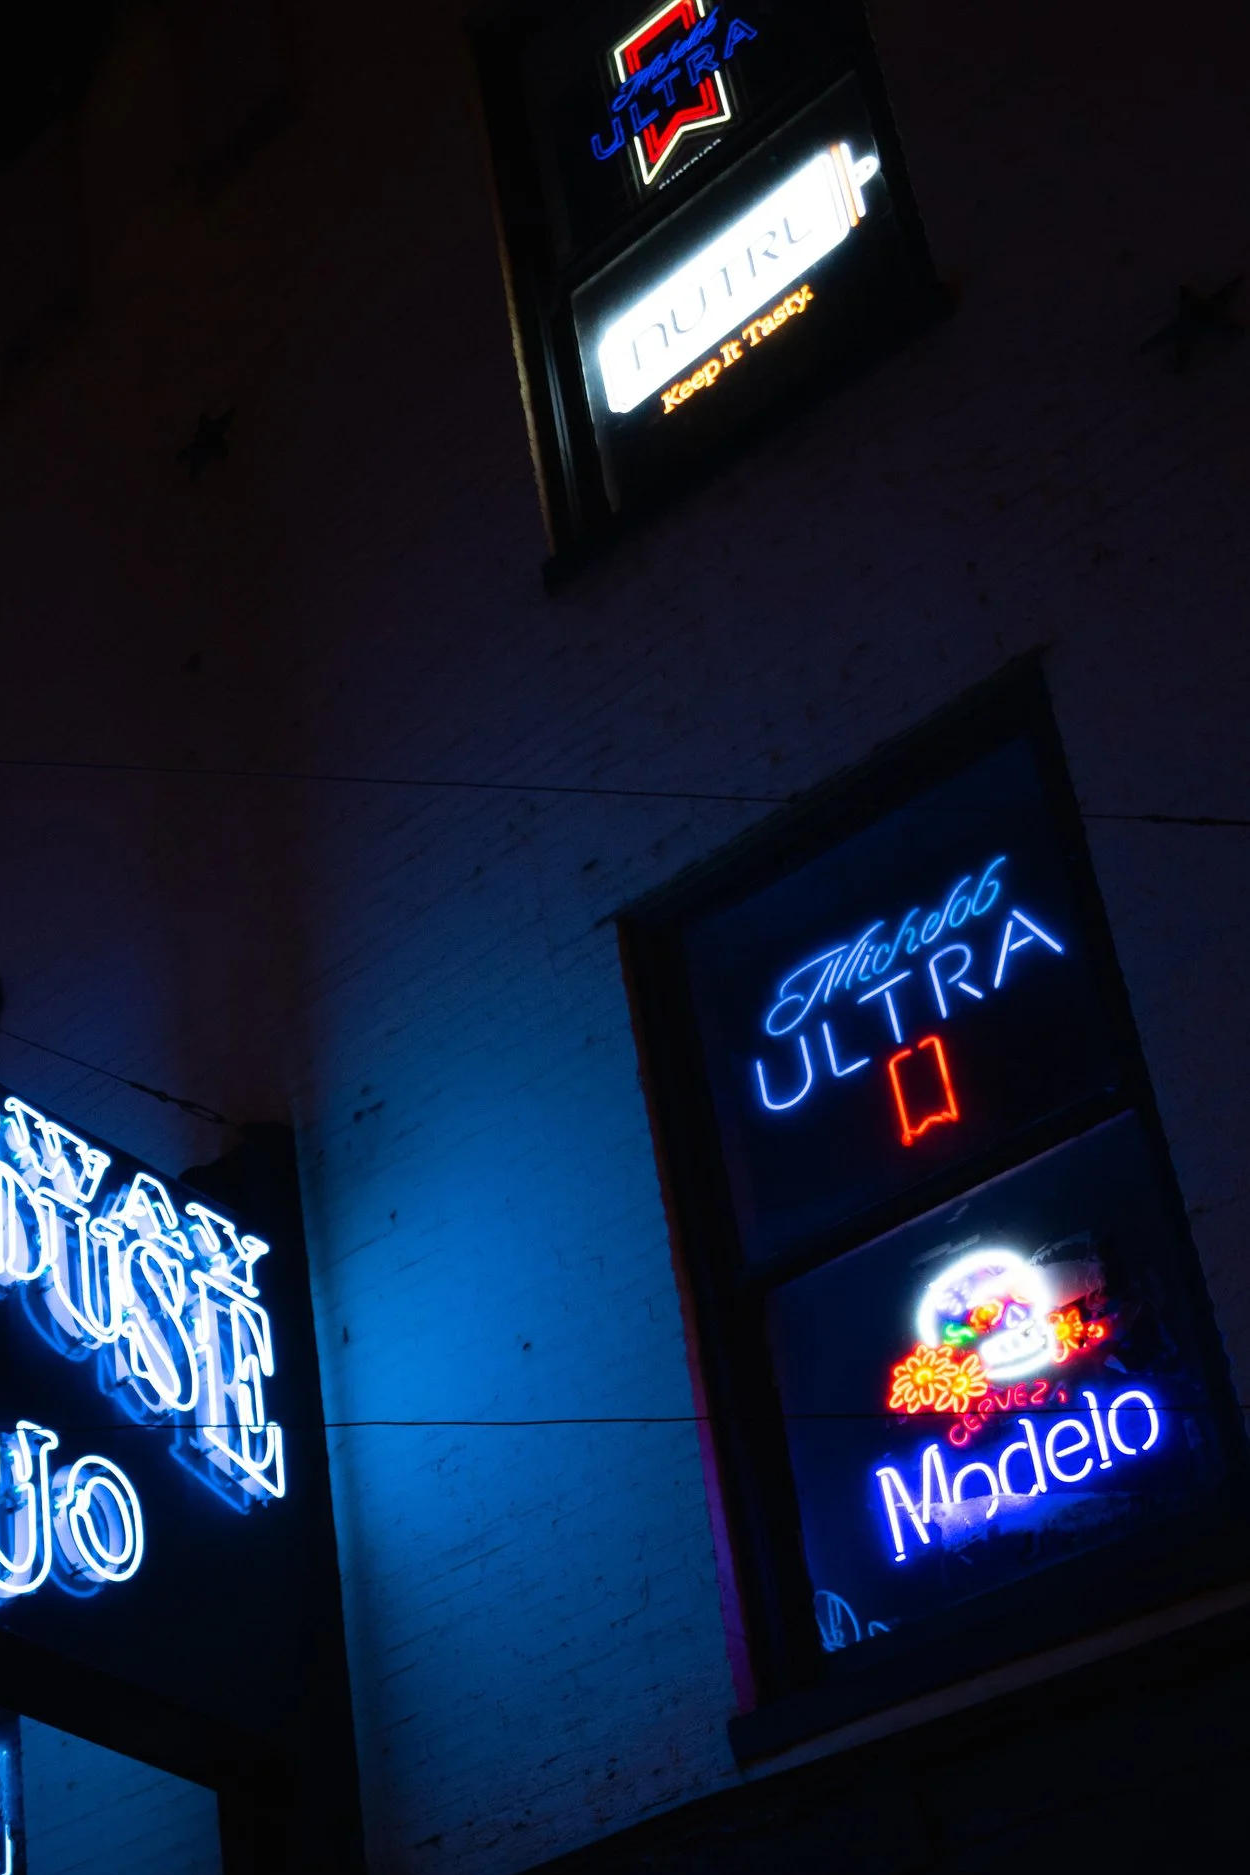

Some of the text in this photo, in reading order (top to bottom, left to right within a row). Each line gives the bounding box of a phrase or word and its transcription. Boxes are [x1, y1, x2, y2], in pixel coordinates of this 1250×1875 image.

[591, 18, 758, 160] ULTRA
[661, 285, 813, 414] Keep It Tasty.
[755, 908, 1064, 1111] ULTRA
[765, 856, 1008, 1037] Michelob
[876, 1389, 1160, 1562] Modelo
